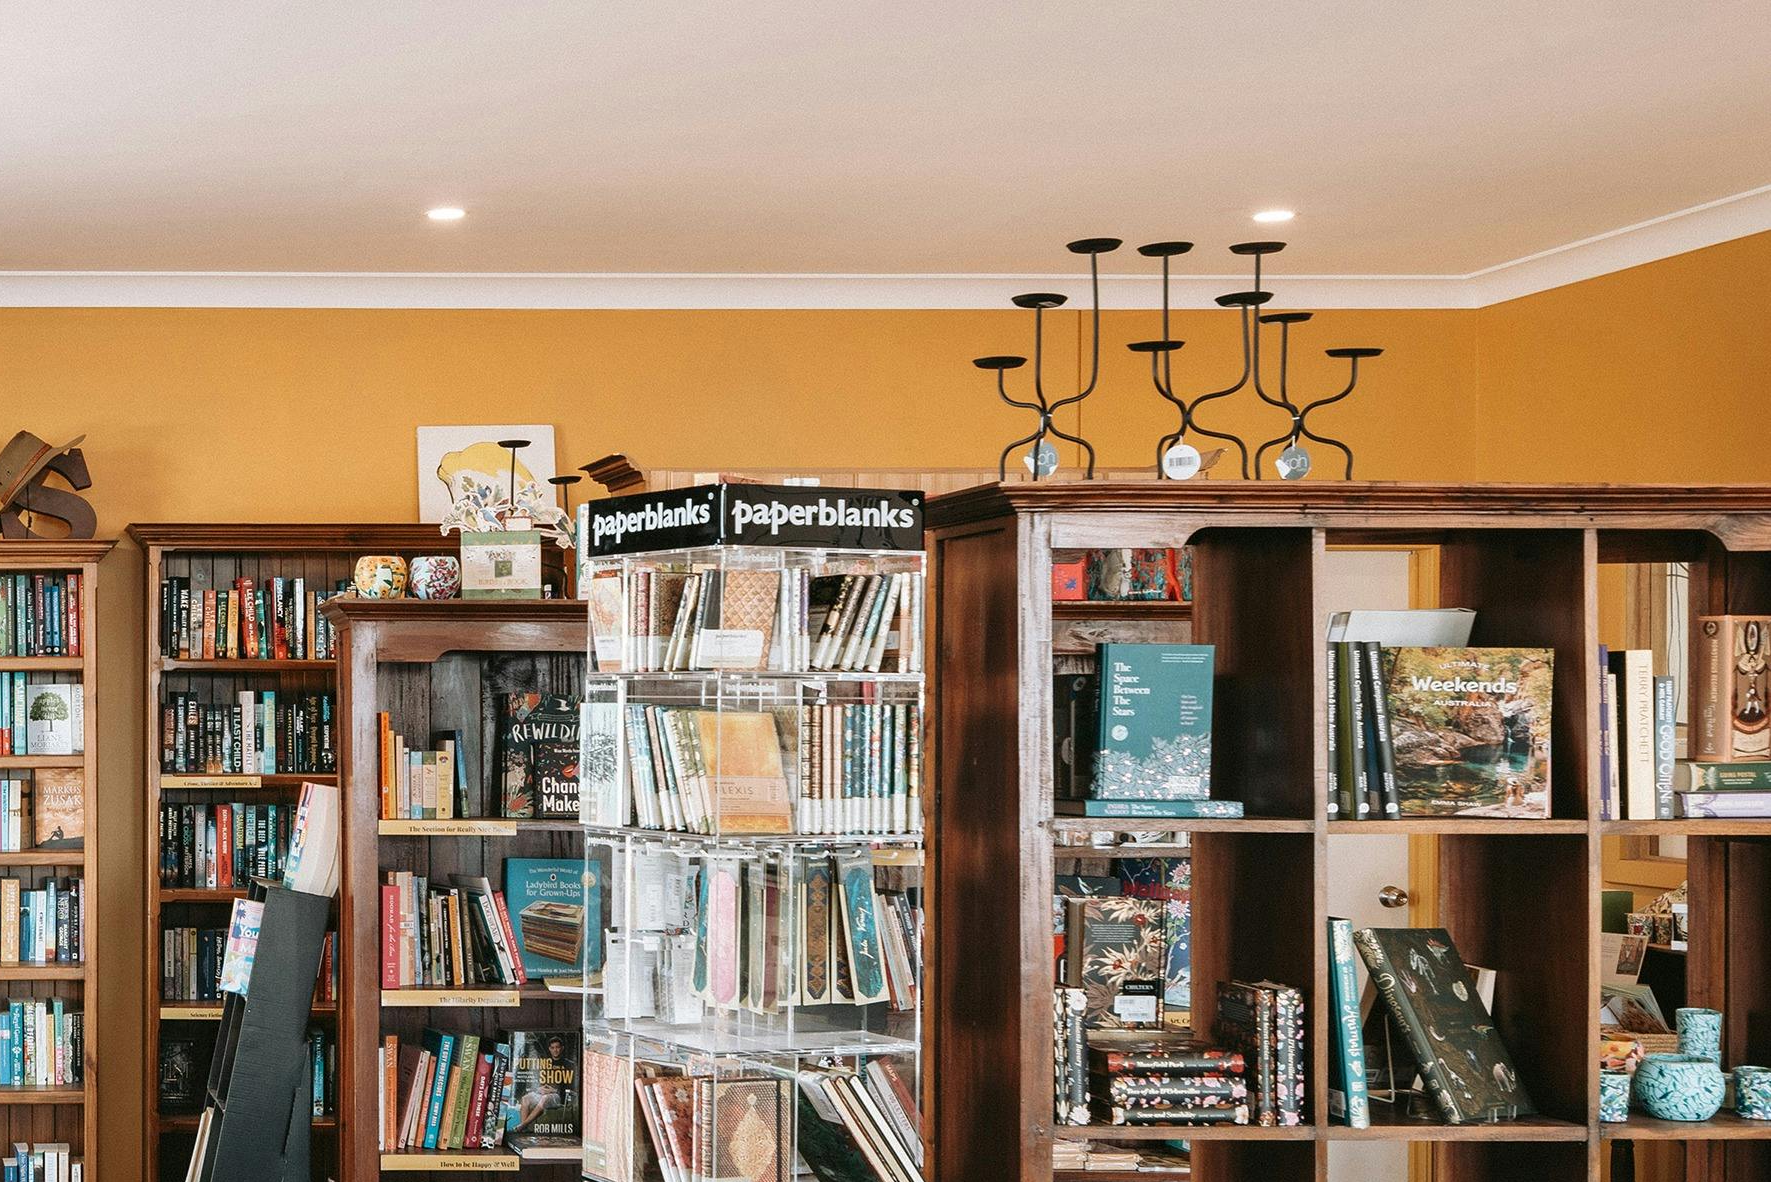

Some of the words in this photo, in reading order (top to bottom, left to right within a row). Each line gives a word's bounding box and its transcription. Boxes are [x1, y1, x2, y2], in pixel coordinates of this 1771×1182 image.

[593, 498, 710, 546] paperblanks
[732, 498, 914, 535] paperblanks
[1114, 662, 1132, 673] The
[1439, 659, 1490, 671] ULTIMATE
[1113, 673, 1140, 686] Space
[1412, 676, 1518, 694] Weekends
[1638, 664, 1649, 697] TERRY
[1113, 684, 1150, 695] Between
[1113, 695, 1131, 706] The
[1433, 699, 1492, 708] AUSTRALIA
[1113, 706, 1135, 718] Stars
[1638, 700, 1650, 763] PRATCHETT
[43, 787, 82, 795] MARKUS
[43, 795, 82, 807] ZUSAK
[1431, 800, 1454, 808] EMMA
[1455, 800, 1482, 808] SHAW
[525, 880, 556, 891] Ladybird
[558, 881, 581, 890] Books
[526, 888, 536, 897] for
[538, 888, 581, 898] Grown-Ups
[539, 1070, 574, 1084] SHOW
[534, 1123, 551, 1133] ROB
[552, 1123, 573, 1134] MILLS
[472, 1161, 492, 1170] Happy
